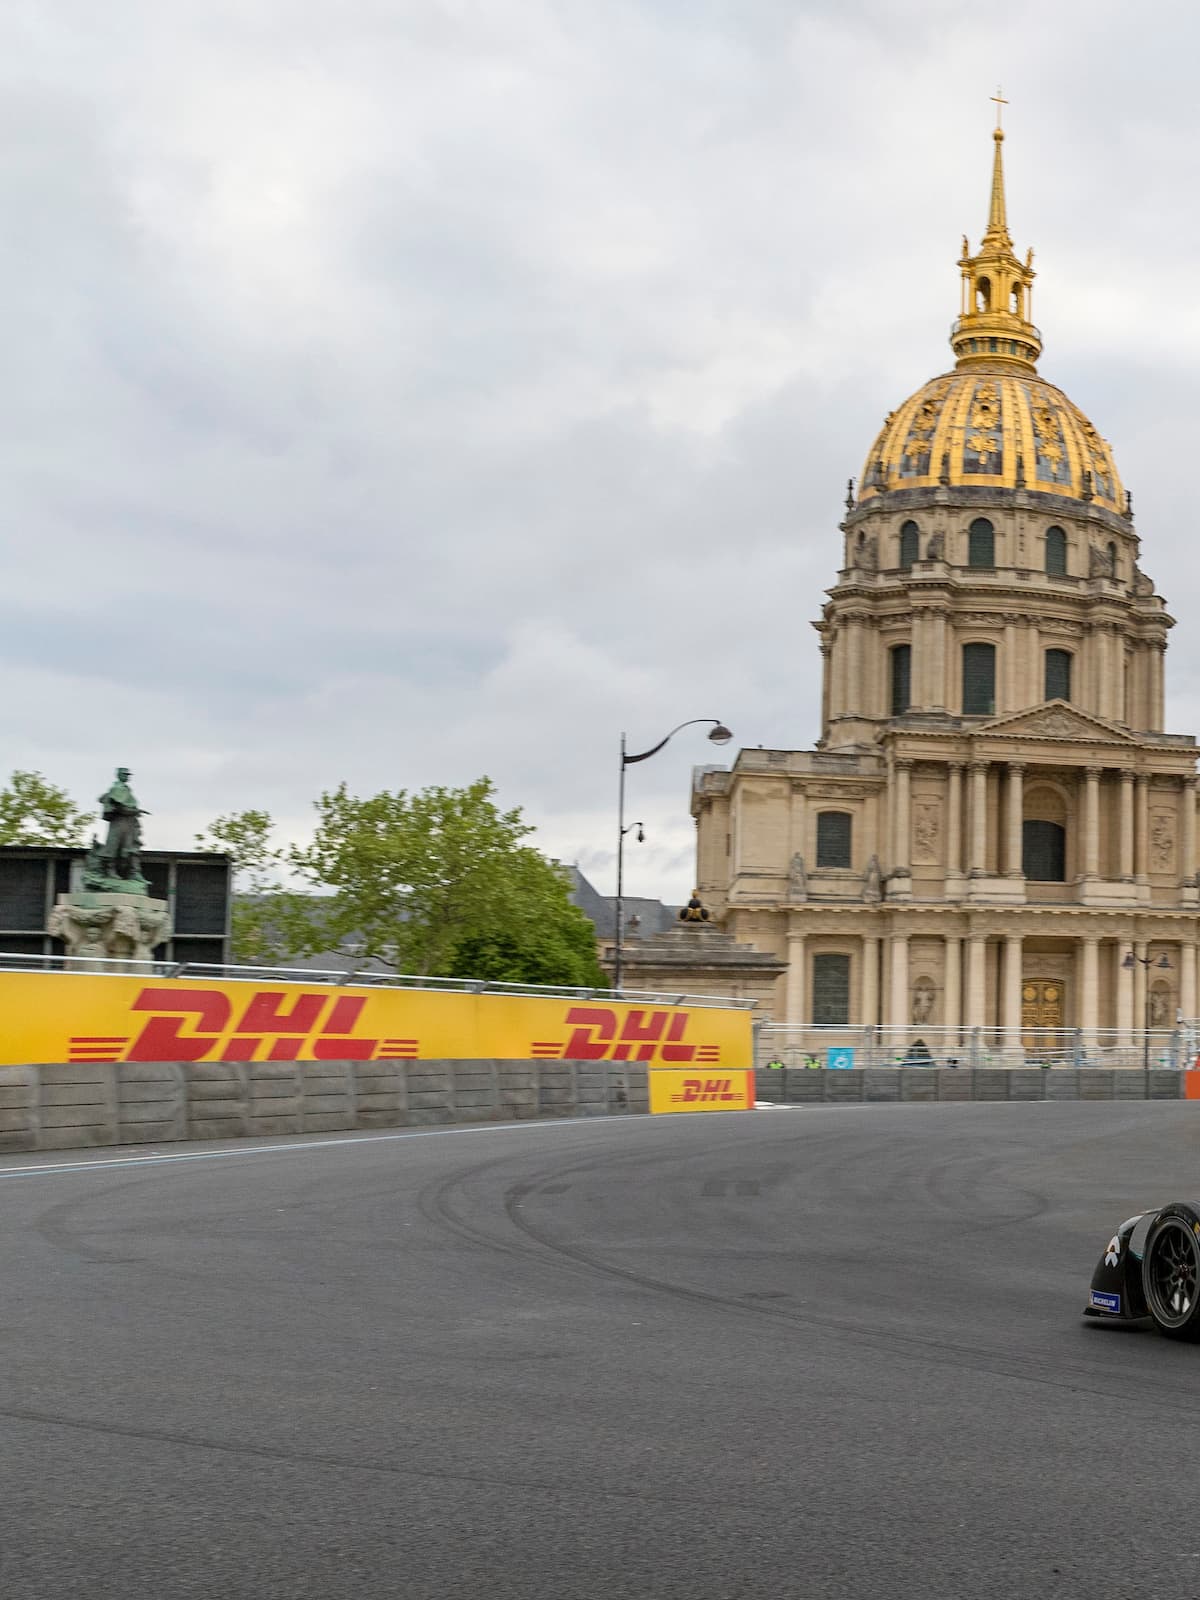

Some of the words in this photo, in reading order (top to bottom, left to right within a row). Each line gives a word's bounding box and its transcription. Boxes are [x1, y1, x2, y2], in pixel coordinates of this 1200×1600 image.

[126, 988, 380, 1062] DHL
[563, 1008, 696, 1062] DHL
[682, 1080, 733, 1103] DHL
